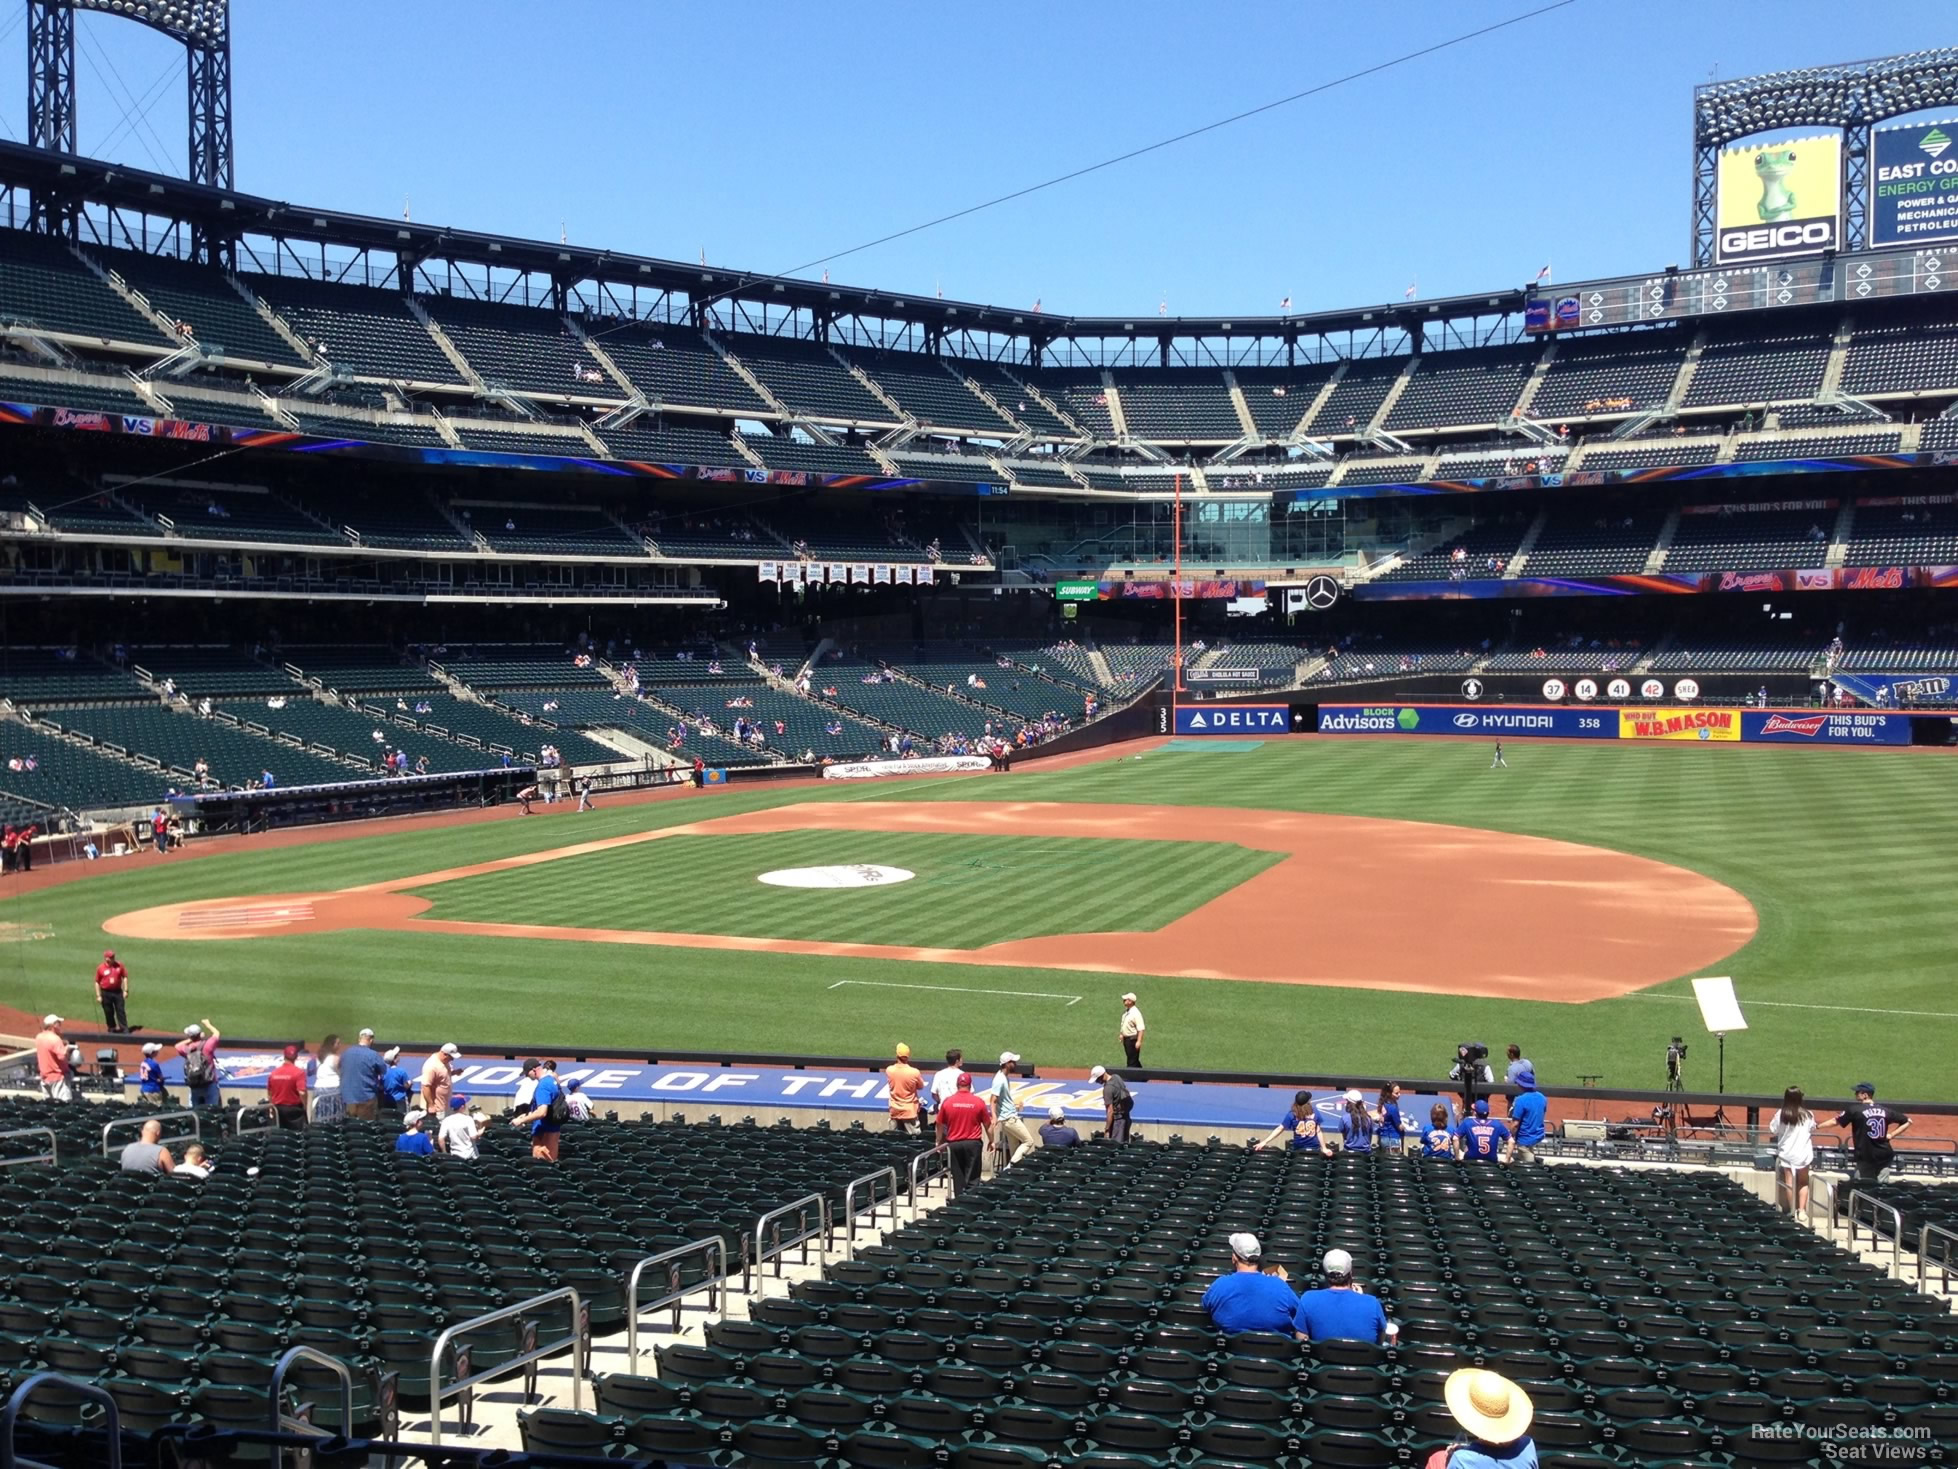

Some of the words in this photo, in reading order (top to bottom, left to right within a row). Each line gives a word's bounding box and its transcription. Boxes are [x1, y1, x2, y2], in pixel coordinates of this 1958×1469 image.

[1878, 162, 1925, 181] EAST
[1930, 159, 1958, 175] CO
[1878, 179, 1936, 197] ENERGY
[1897, 196, 1934, 209] POWER
[1937, 195, 1945, 205] &
[1721, 222, 1830, 253] GEICO
[1718, 266, 1768, 277] LEAGUE
[124, 417, 152, 434] VS
[745, 470, 766, 482] VS
[1541, 475, 1562, 487] VS
[1800, 575, 1829, 587] VS
[1849, 567, 1903, 588] Mets
[1059, 585, 1096, 595] SUBWAY
[1547, 684, 1561, 695] 37
[1580, 684, 1592, 695] 14
[1613, 684, 1626, 695] 41
[1645, 684, 1660, 695] 42
[1677, 685, 1696, 694] SHEA
[1363, 708, 1394, 716] BLOCK
[1624, 712, 1640, 720] WHO
[1641, 712, 1657, 720] BUT
[1213, 712, 1284, 726] DELTA
[1320, 713, 1395, 729] Advisors
[1482, 715, 1553, 728] HYUNDAI
[1578, 718, 1601, 728] 358
[1766, 719, 1821, 730] Budweiser
[1829, 715, 1852, 726] THIS
[1854, 715, 1886, 726] BUD'S
[1828, 727, 1848, 737] FOR
[1851, 727, 1875, 738] YOU.
[651, 1072, 760, 1092] OF
[1866, 1117, 1886, 1139] 31
[1478, 1136, 1491, 1154] 5
